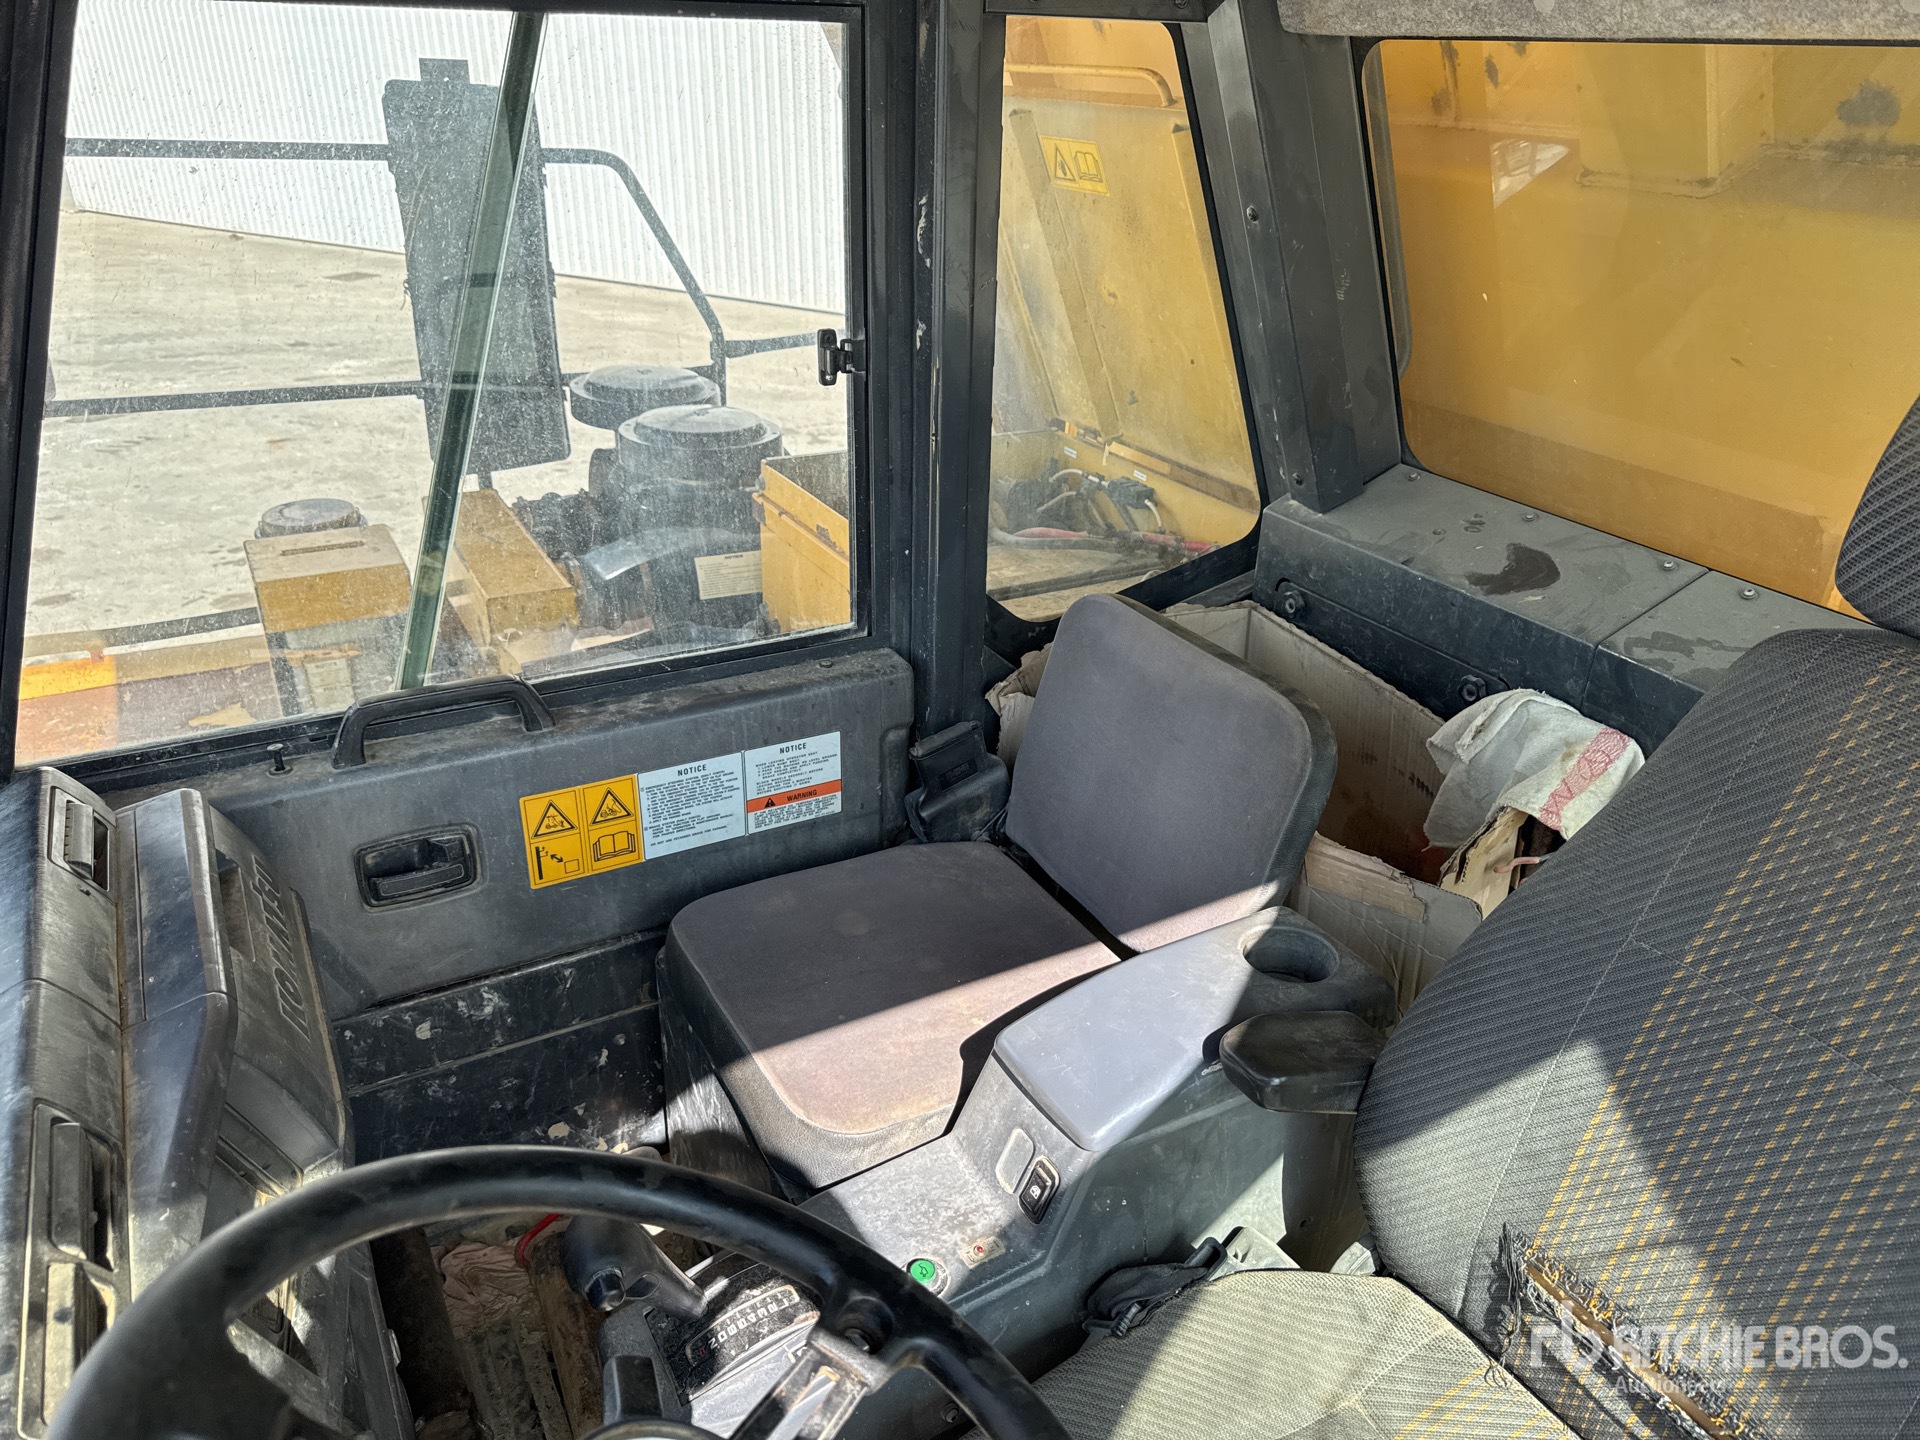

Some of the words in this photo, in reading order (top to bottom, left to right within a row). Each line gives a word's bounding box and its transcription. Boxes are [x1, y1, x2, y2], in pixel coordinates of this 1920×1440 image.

[780, 743, 807, 754] NOTICE
[678, 764, 707, 776] NOTICE
[787, 790, 817, 802] WARNING
[250, 854, 310, 1041] KOMATSU
[708, 1337, 718, 1350] N
